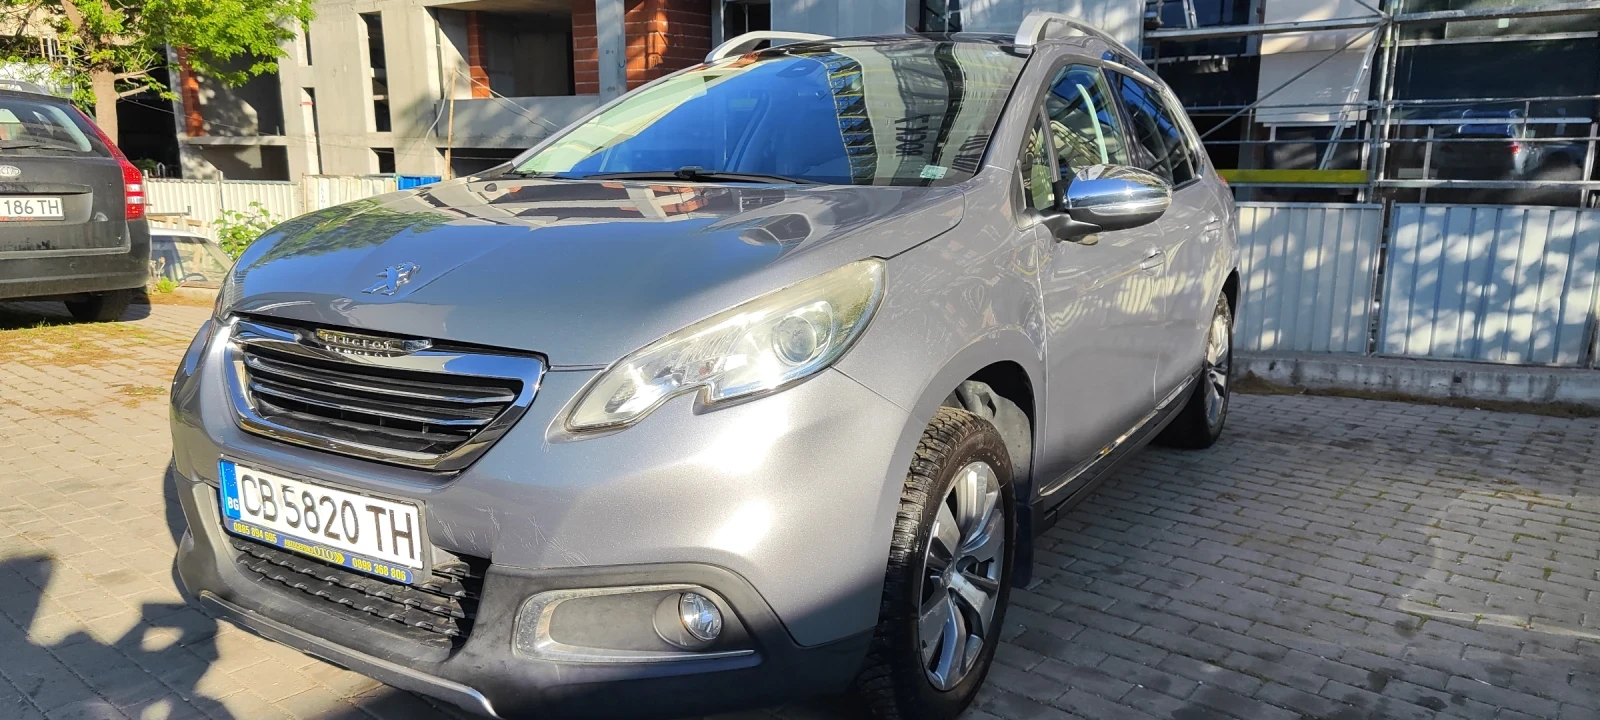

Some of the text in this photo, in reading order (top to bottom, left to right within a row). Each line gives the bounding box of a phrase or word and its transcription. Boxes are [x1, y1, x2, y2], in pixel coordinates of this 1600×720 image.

[4, 199, 60, 215] 186 TH
[227, 496, 239, 510] BG
[241, 474, 415, 560] CB 5820 TH
